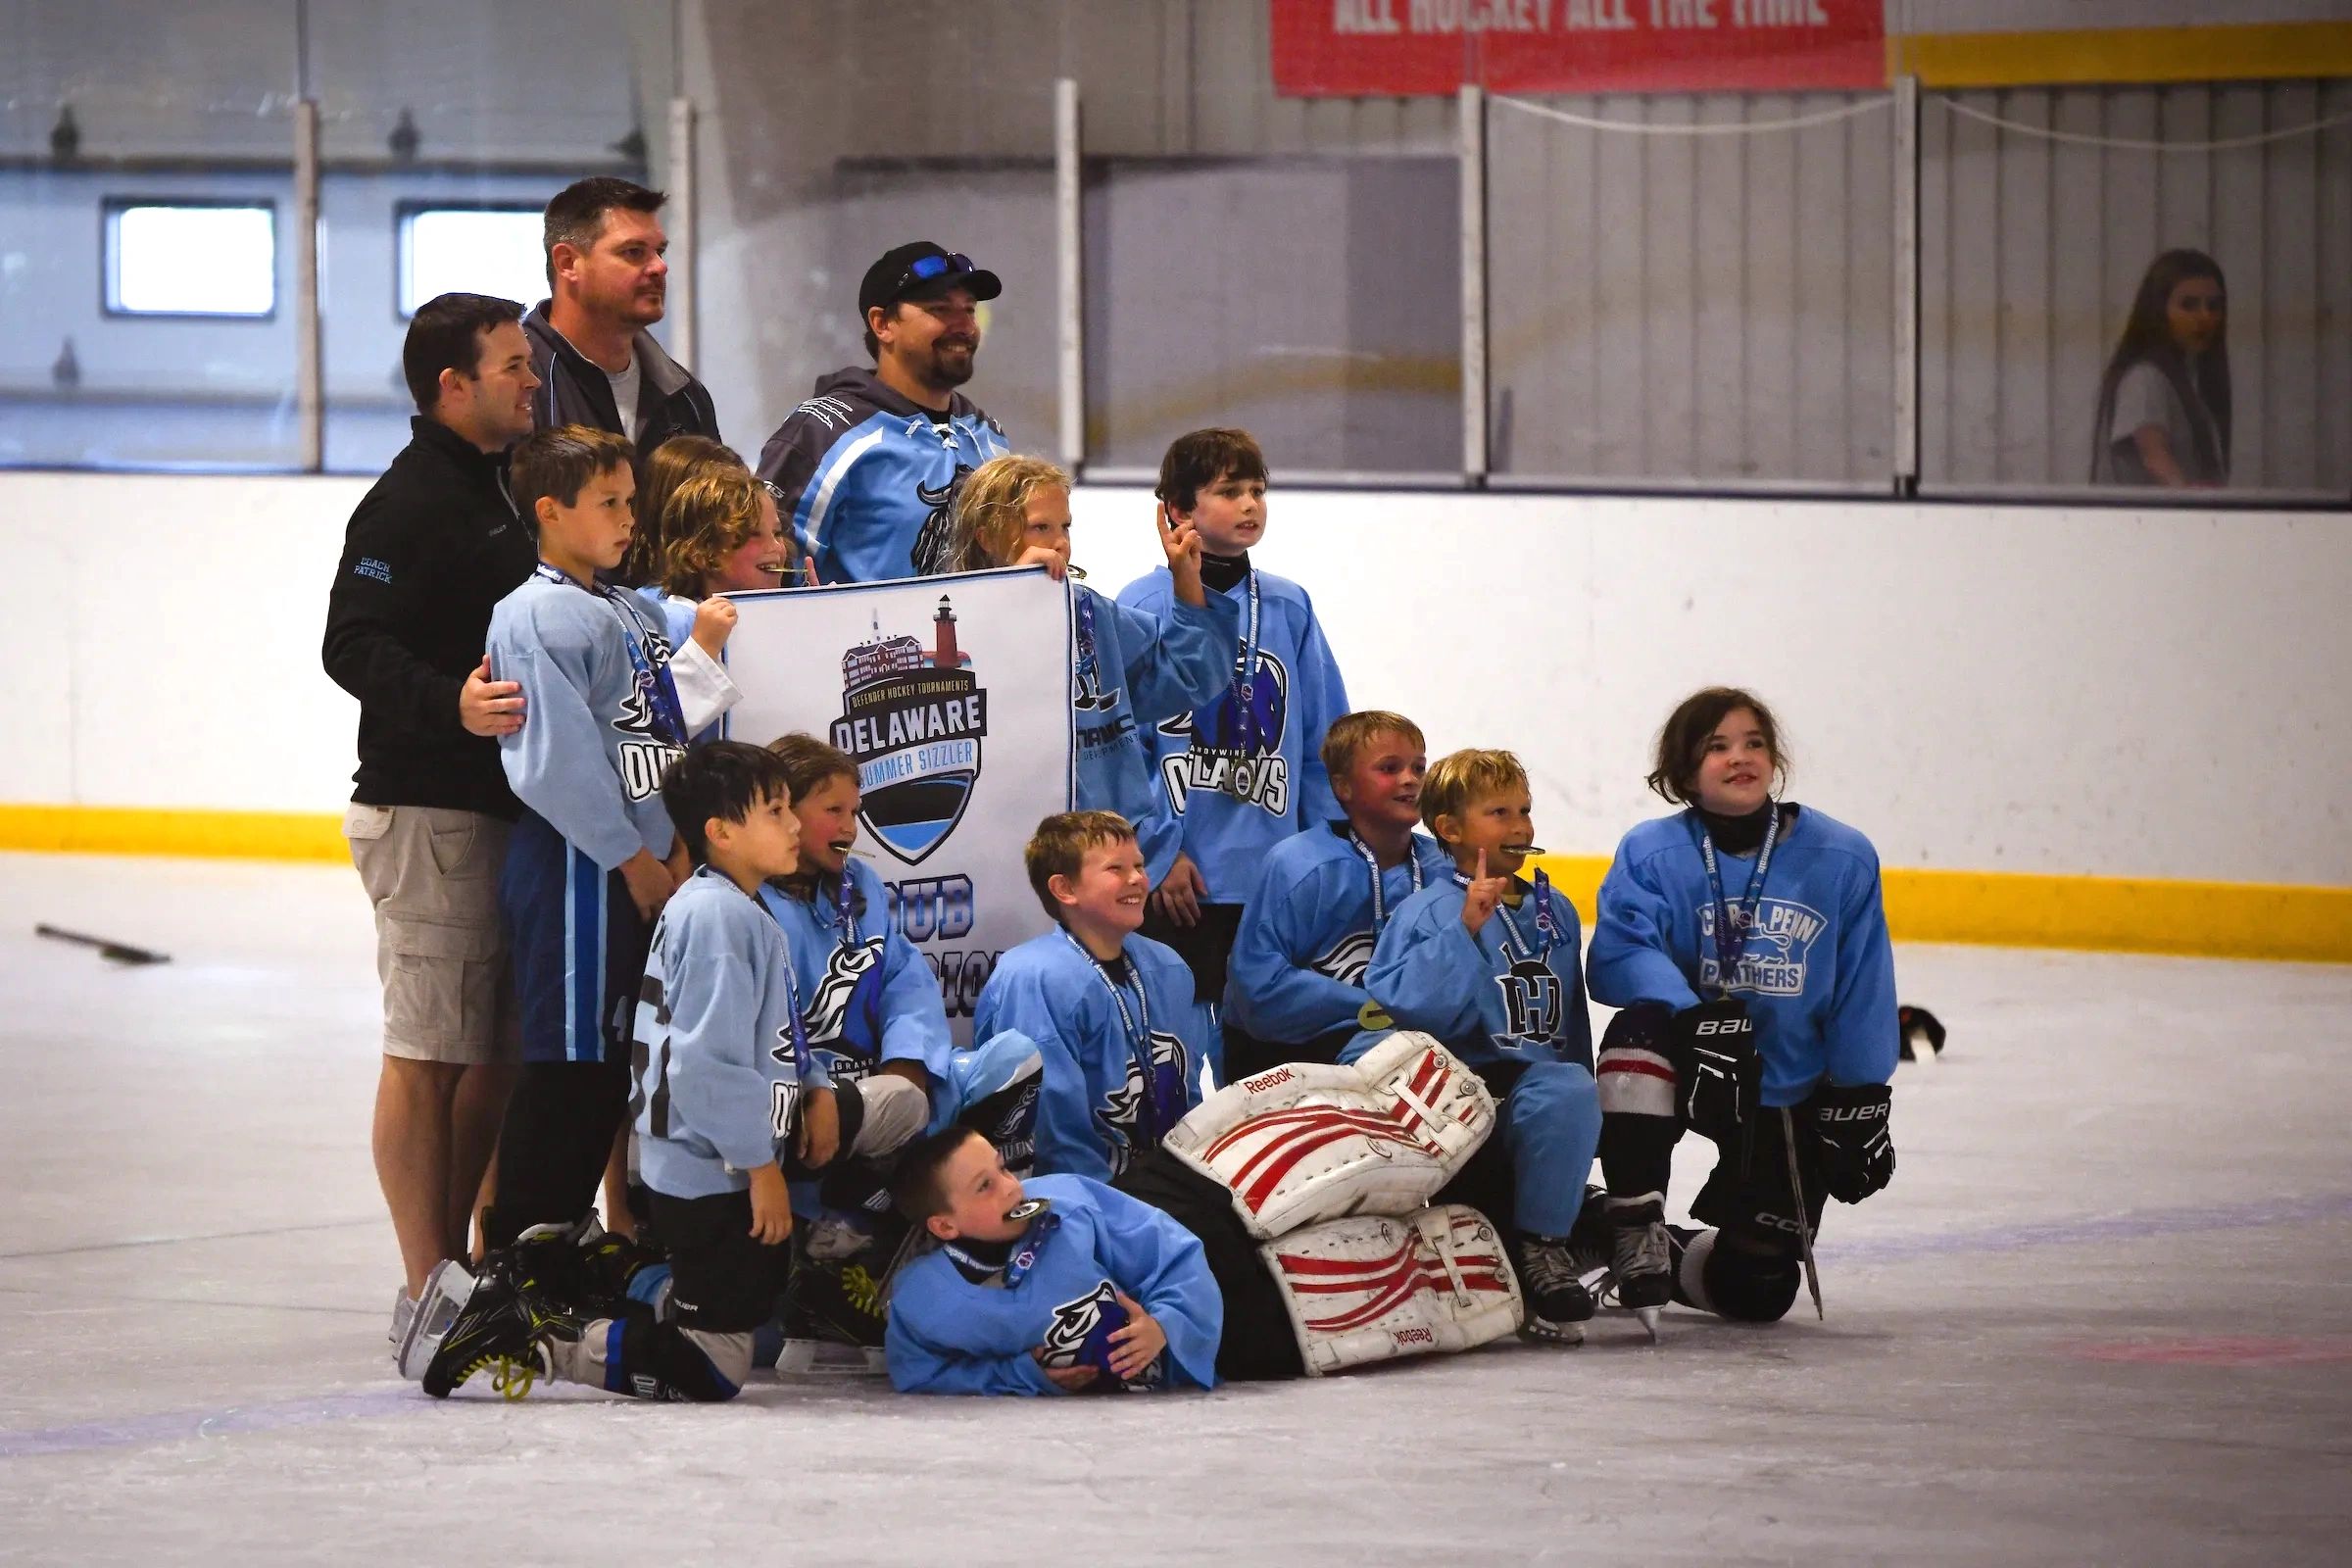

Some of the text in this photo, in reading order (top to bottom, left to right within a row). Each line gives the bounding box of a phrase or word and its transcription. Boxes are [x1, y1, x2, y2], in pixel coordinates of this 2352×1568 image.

[353, 564, 392, 584] PATRICK
[360, 557, 391, 573] COACH
[852, 679, 969, 709] DEFENDER HOCKEY TOURNAMENTS
[835, 694, 981, 756] DELAWARE
[859, 741, 973, 789] UMMER SIZZLER
[1189, 745, 1247, 760] ANDYWINE
[883, 873, 973, 943] UB
[1768, 905, 1819, 943] PENN
[1705, 962, 1799, 988] PNTHERS
[1244, 1067, 1296, 1095] Reebok
[1819, 1102, 1888, 1121] AUER
[1393, 1328, 1433, 1346] Reebok
